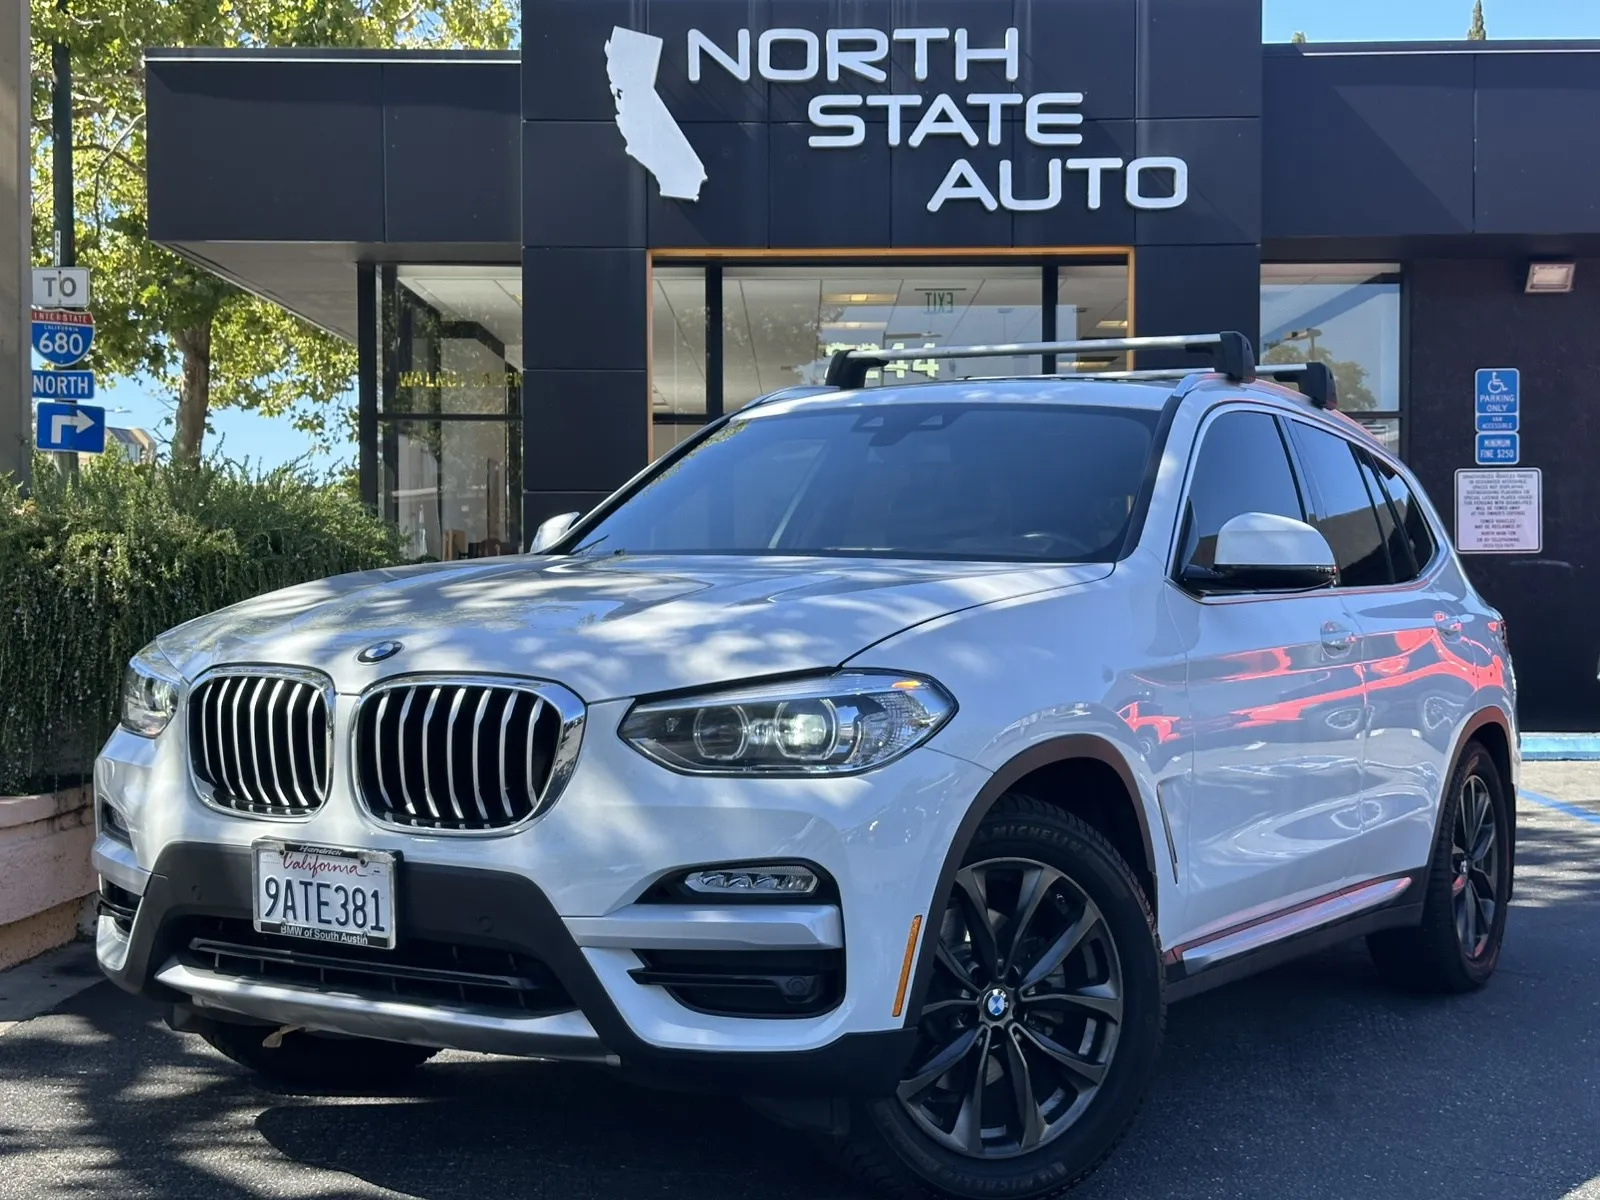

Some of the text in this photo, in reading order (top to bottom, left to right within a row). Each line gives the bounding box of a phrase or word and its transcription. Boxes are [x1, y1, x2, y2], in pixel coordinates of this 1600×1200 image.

[687, 27, 1019, 82] NORTH
[808, 92, 1083, 147] STATE
[926, 157, 1188, 212] AUTO
[42, 276, 77, 298] TO
[33, 311, 88, 324] INTERSTATE
[43, 324, 79, 332] CALIFORNIA
[39, 331, 83, 355] 680
[33, 374, 89, 395] NORTH
[1479, 394, 1515, 403] PARKING
[1486, 404, 1508, 412] ONLY
[1480, 449, 1494, 458] FINE
[282, 851, 368, 879] California
[264, 876, 385, 932] 9ATE381
[280, 925, 368, 945] BMW of South Austin
